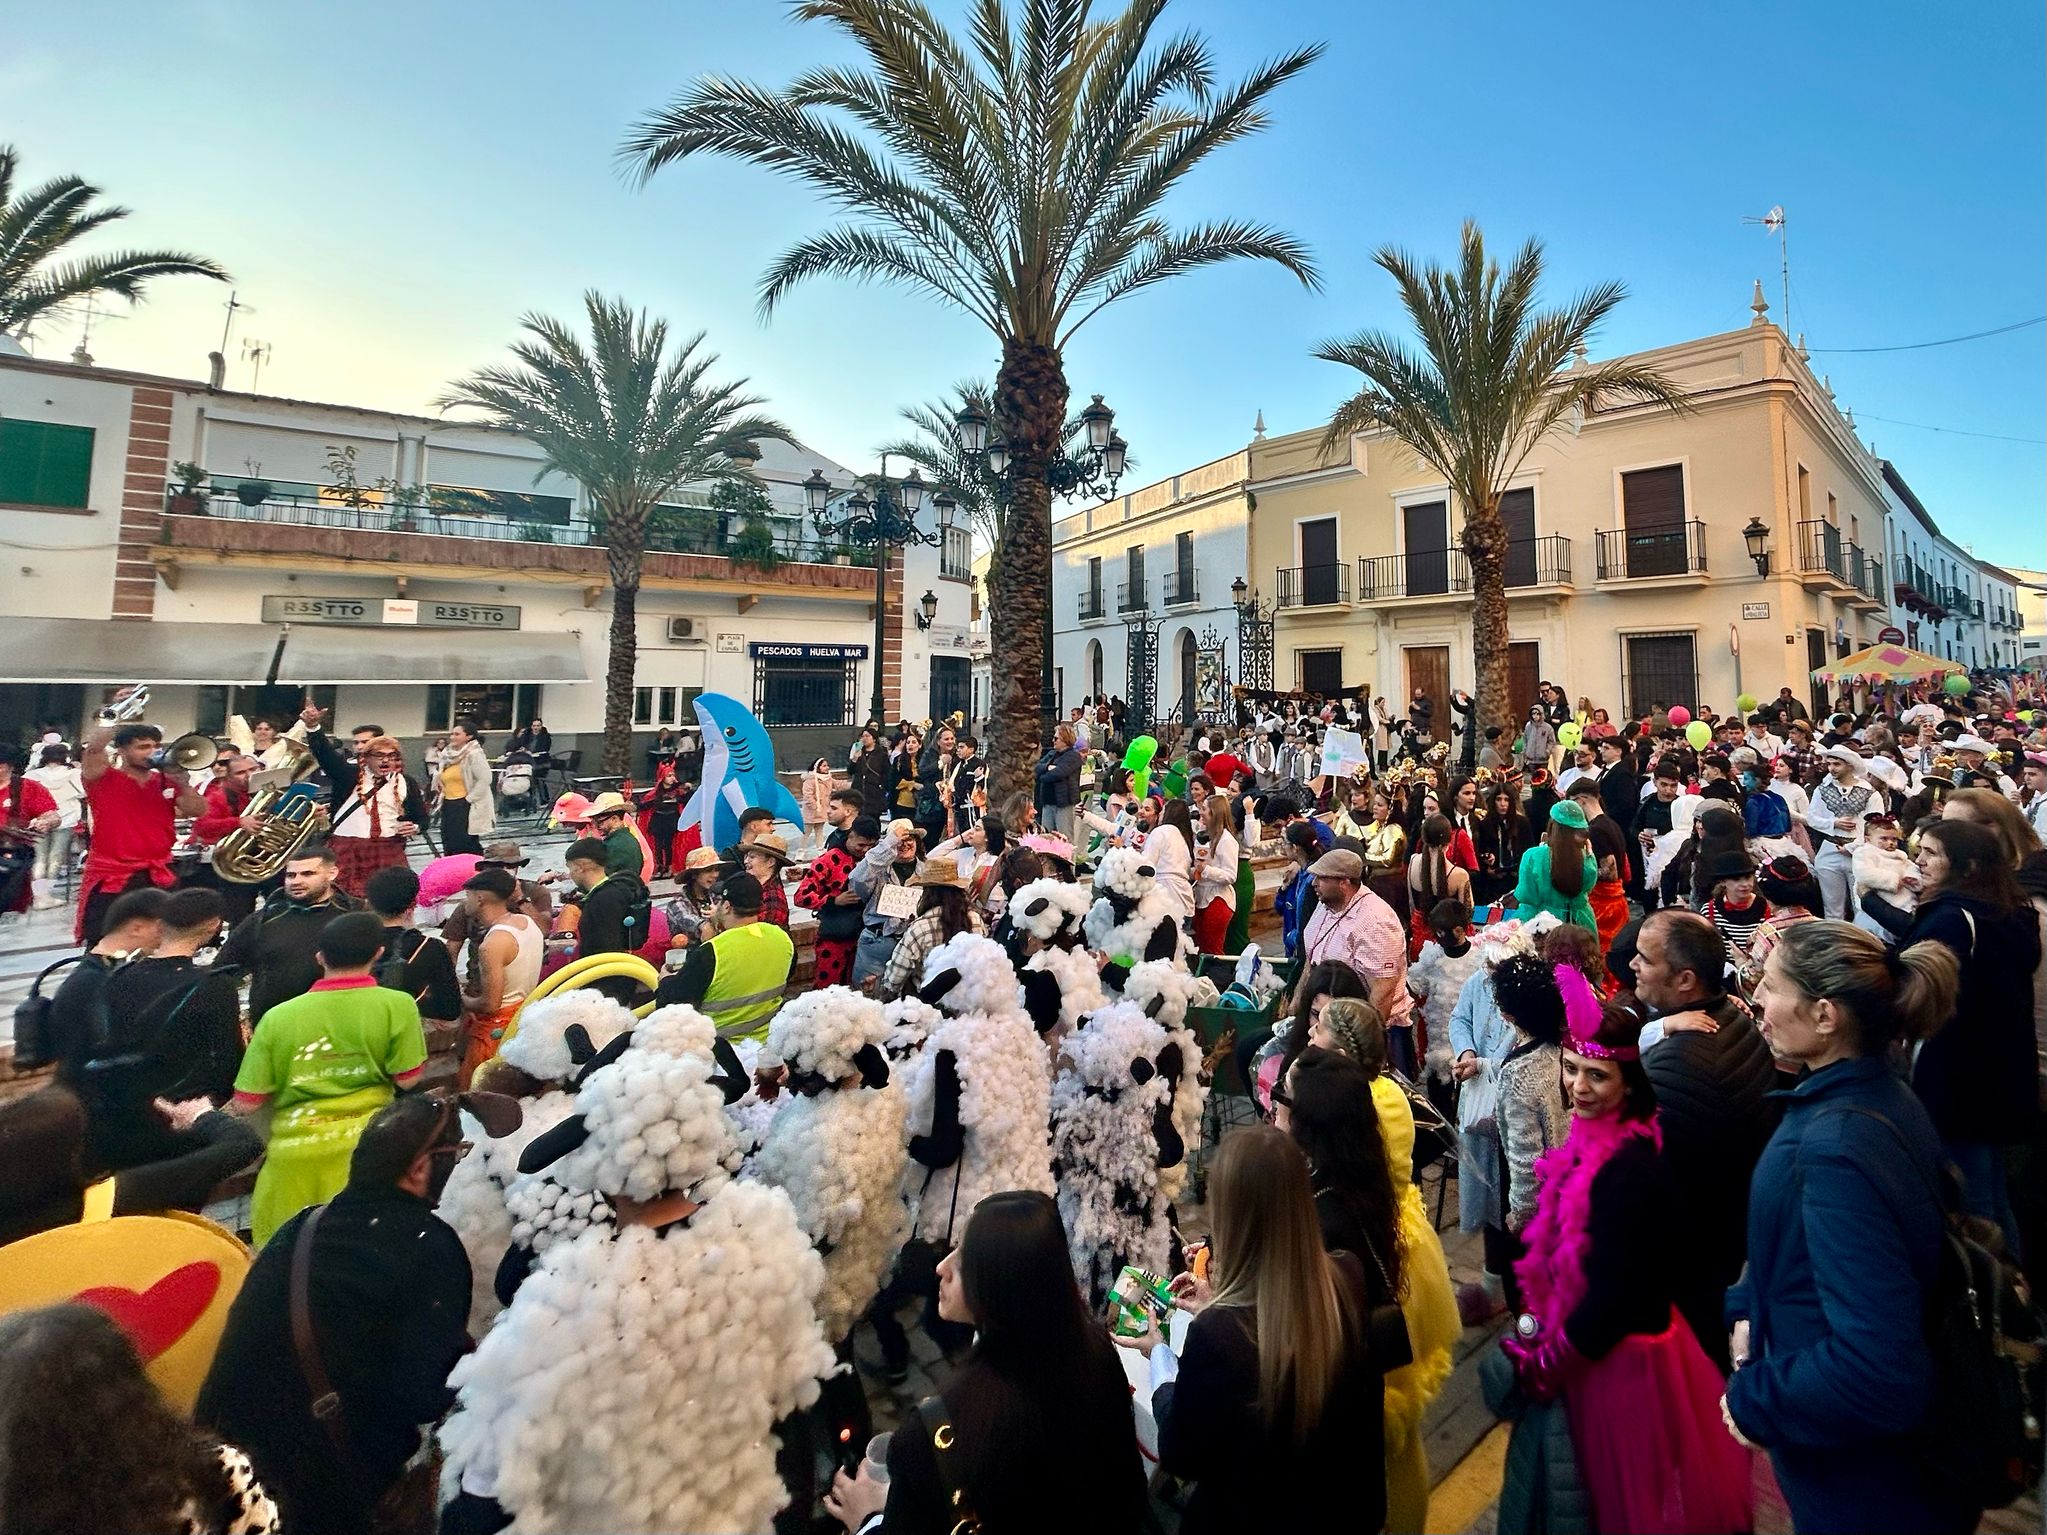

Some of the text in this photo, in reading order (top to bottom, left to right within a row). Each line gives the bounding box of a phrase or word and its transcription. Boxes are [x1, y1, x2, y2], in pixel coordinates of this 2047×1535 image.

[435, 606, 504, 622] R3STTO
[757, 646, 862, 657] PESCADOS HUELVA MAR
